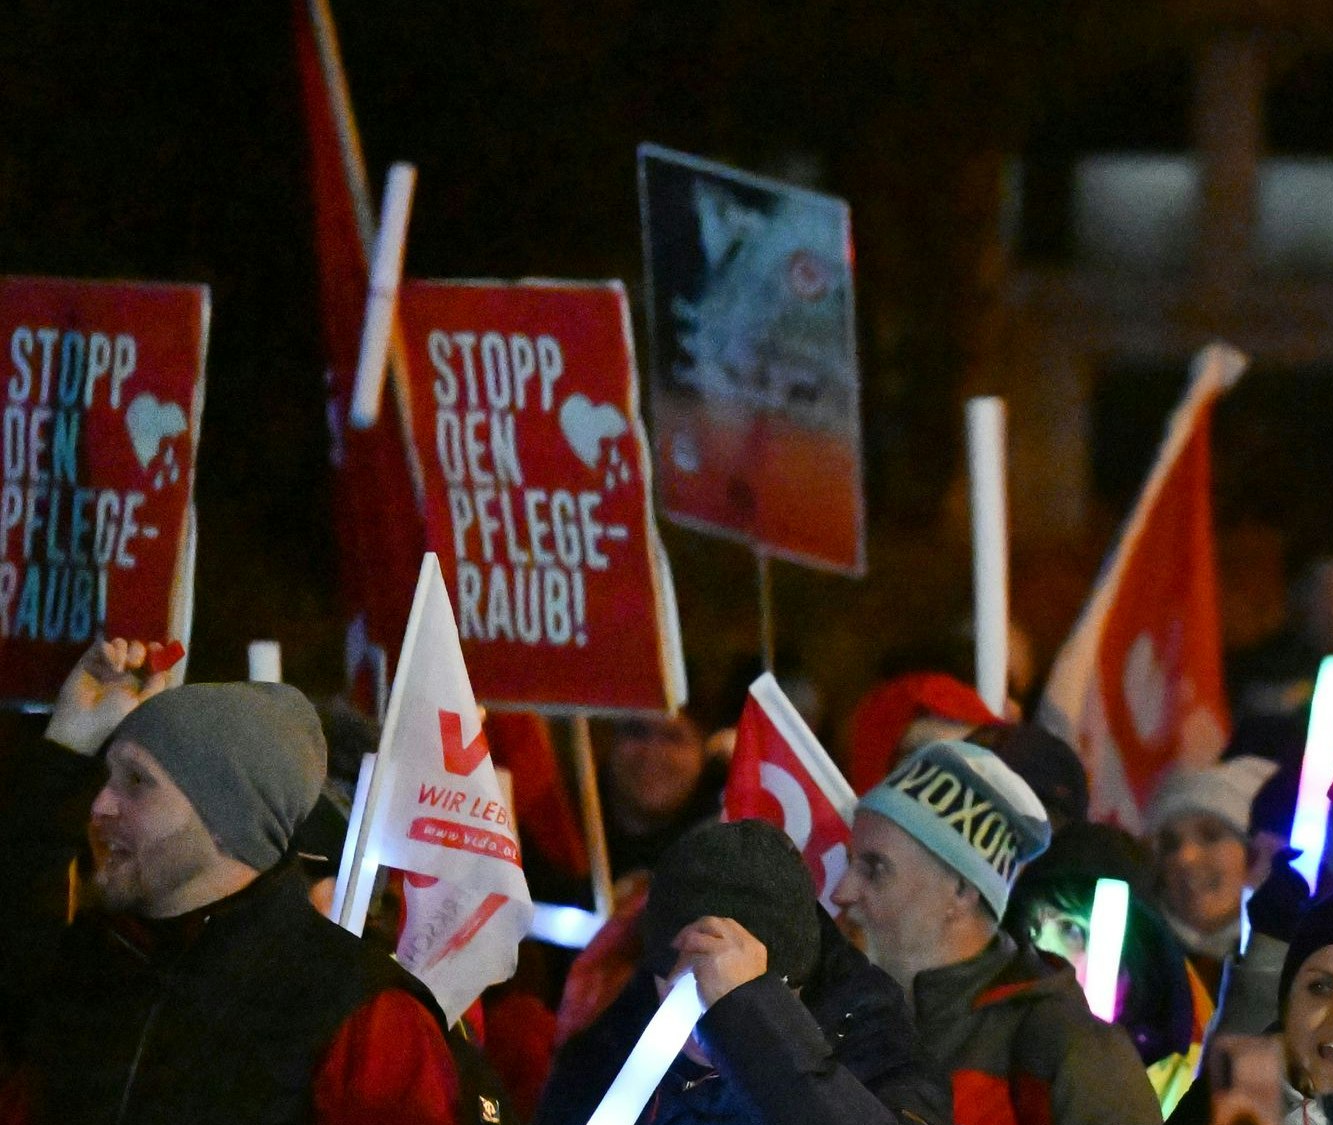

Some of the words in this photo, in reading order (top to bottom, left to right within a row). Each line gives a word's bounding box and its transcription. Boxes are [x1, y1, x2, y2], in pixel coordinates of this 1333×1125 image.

[8, 325, 138, 408] STOPP
[428, 329, 564, 413] STOPP
[3, 406, 81, 485] DEN
[436, 405, 523, 487] DEN
[0, 482, 159, 569] PFLEGE-
[449, 486, 628, 571] PFLEGE-
[457, 559, 588, 648] RAUB!
[418, 783, 467, 813] WIR
